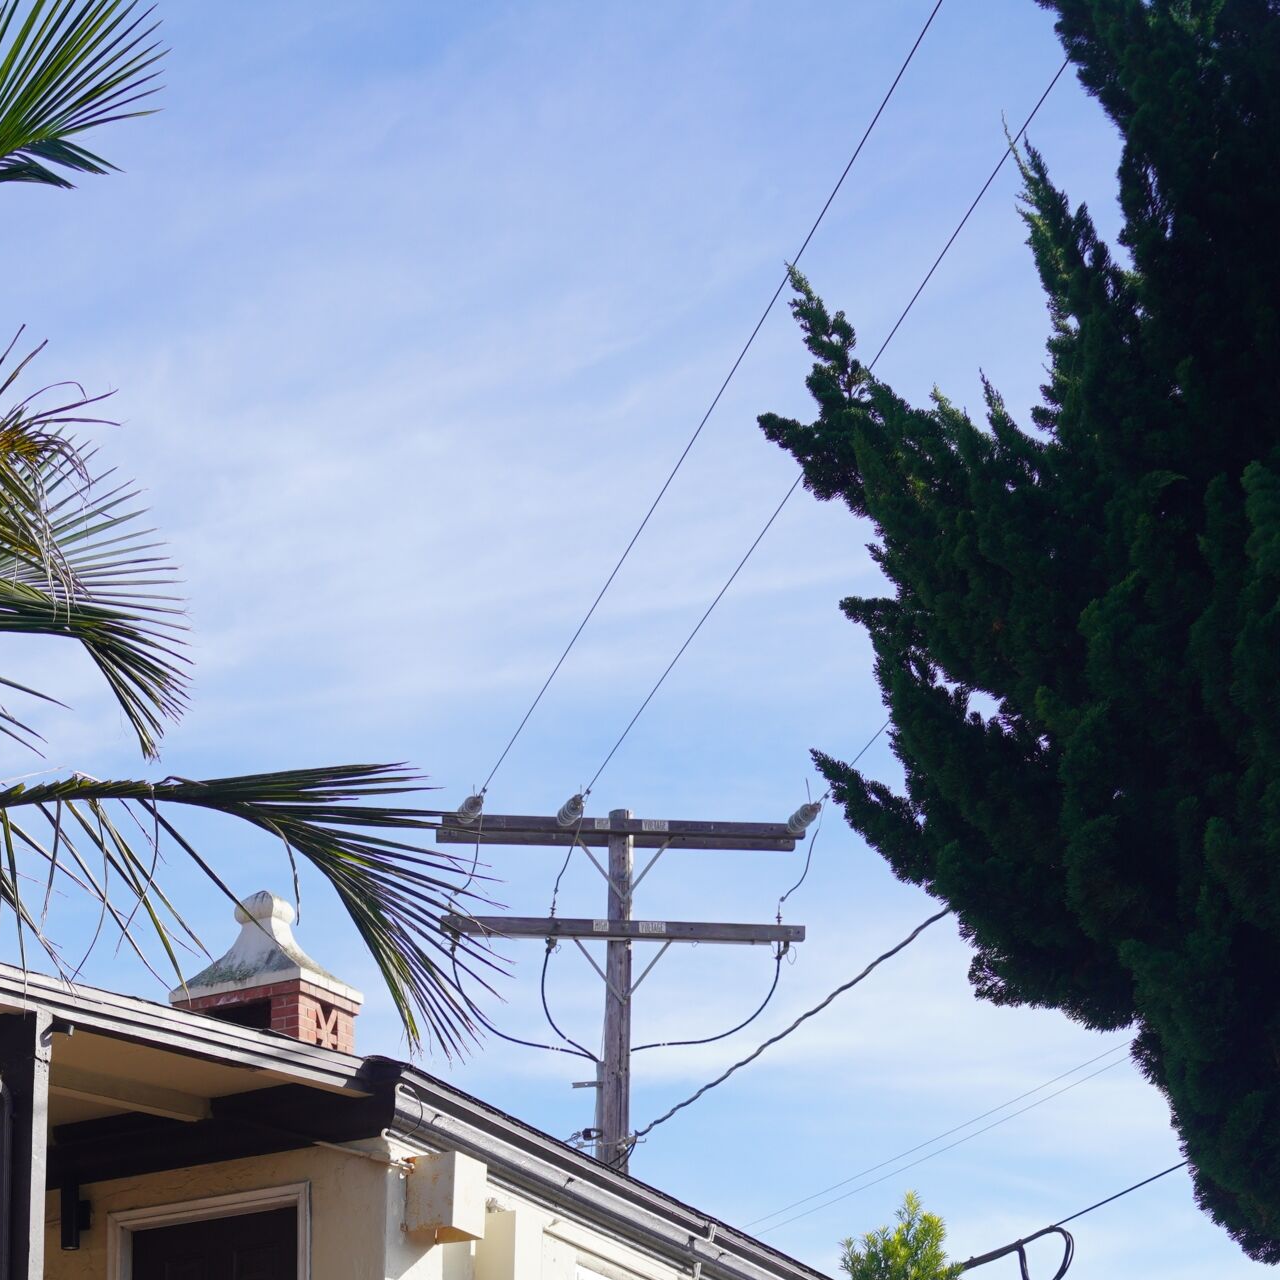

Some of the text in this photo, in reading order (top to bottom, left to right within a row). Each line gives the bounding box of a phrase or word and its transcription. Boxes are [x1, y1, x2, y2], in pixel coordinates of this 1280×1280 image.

[642, 821, 669, 831] VOLTAGE
[594, 920, 666, 933] HIGH VOLTAGE
